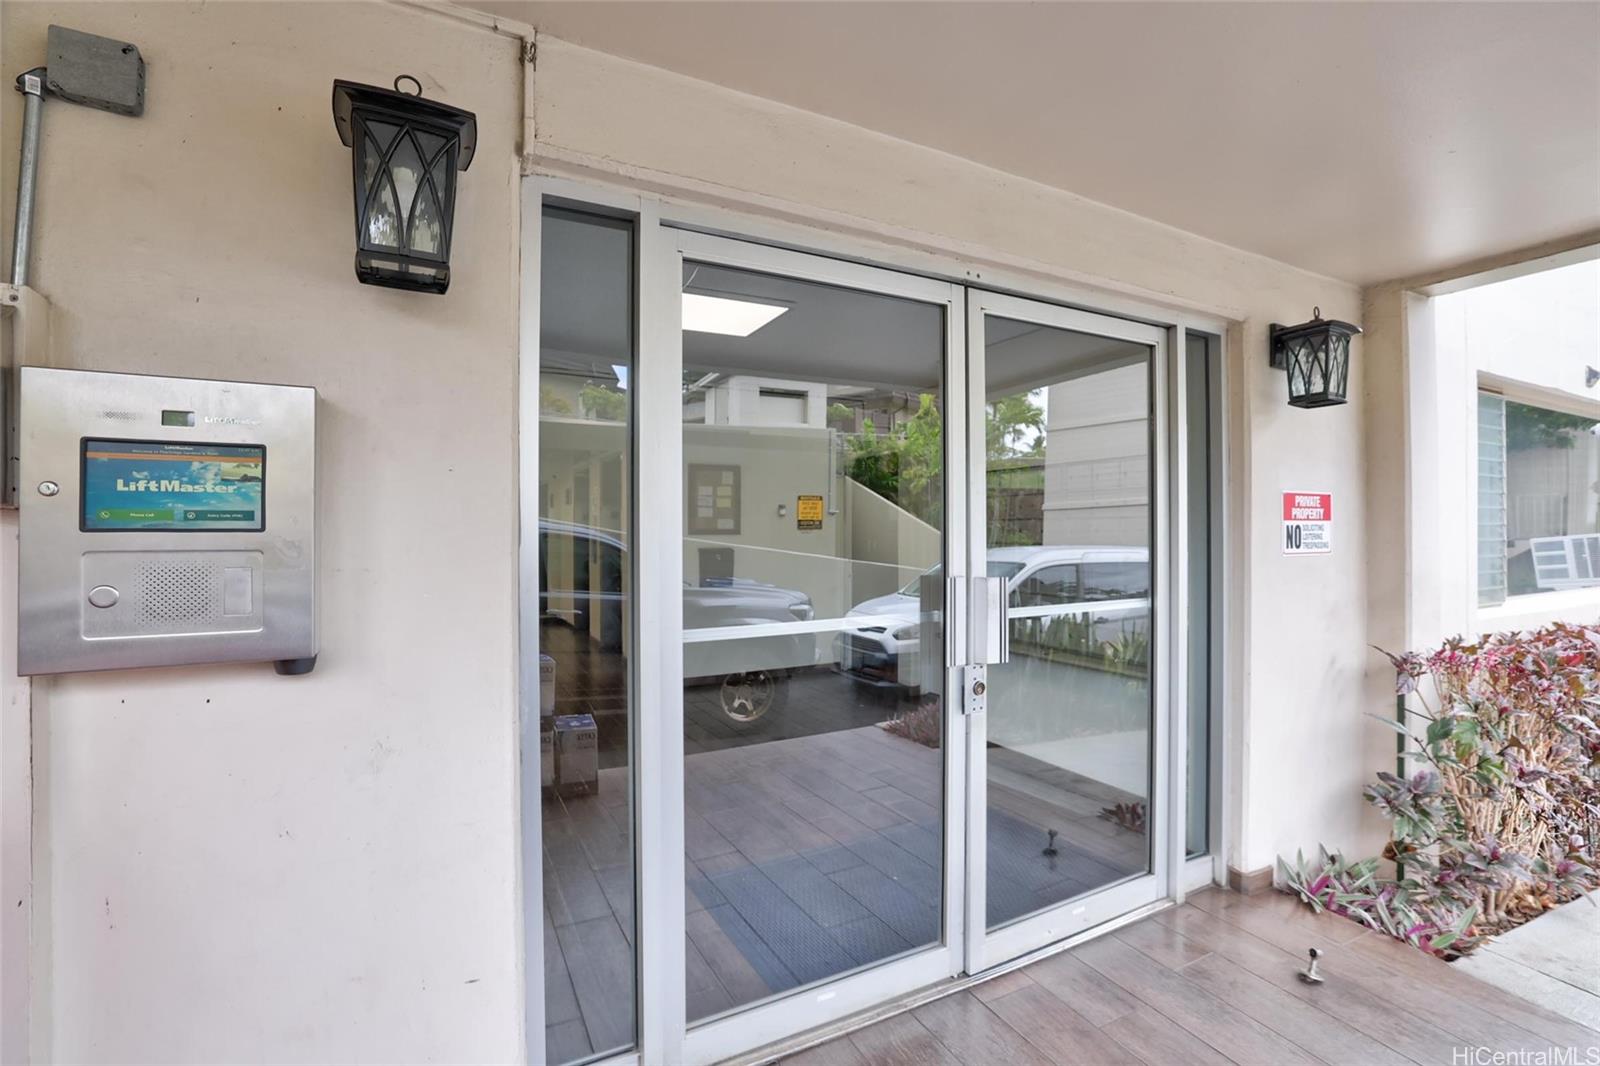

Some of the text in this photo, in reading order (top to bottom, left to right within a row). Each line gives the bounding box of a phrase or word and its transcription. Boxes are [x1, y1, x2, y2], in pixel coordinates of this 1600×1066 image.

[116, 479, 238, 494] LiftMaster
[1294, 495, 1321, 507] PRIVATE
[1291, 508, 1325, 519] PROPERTY
[1286, 524, 1302, 550] NO
